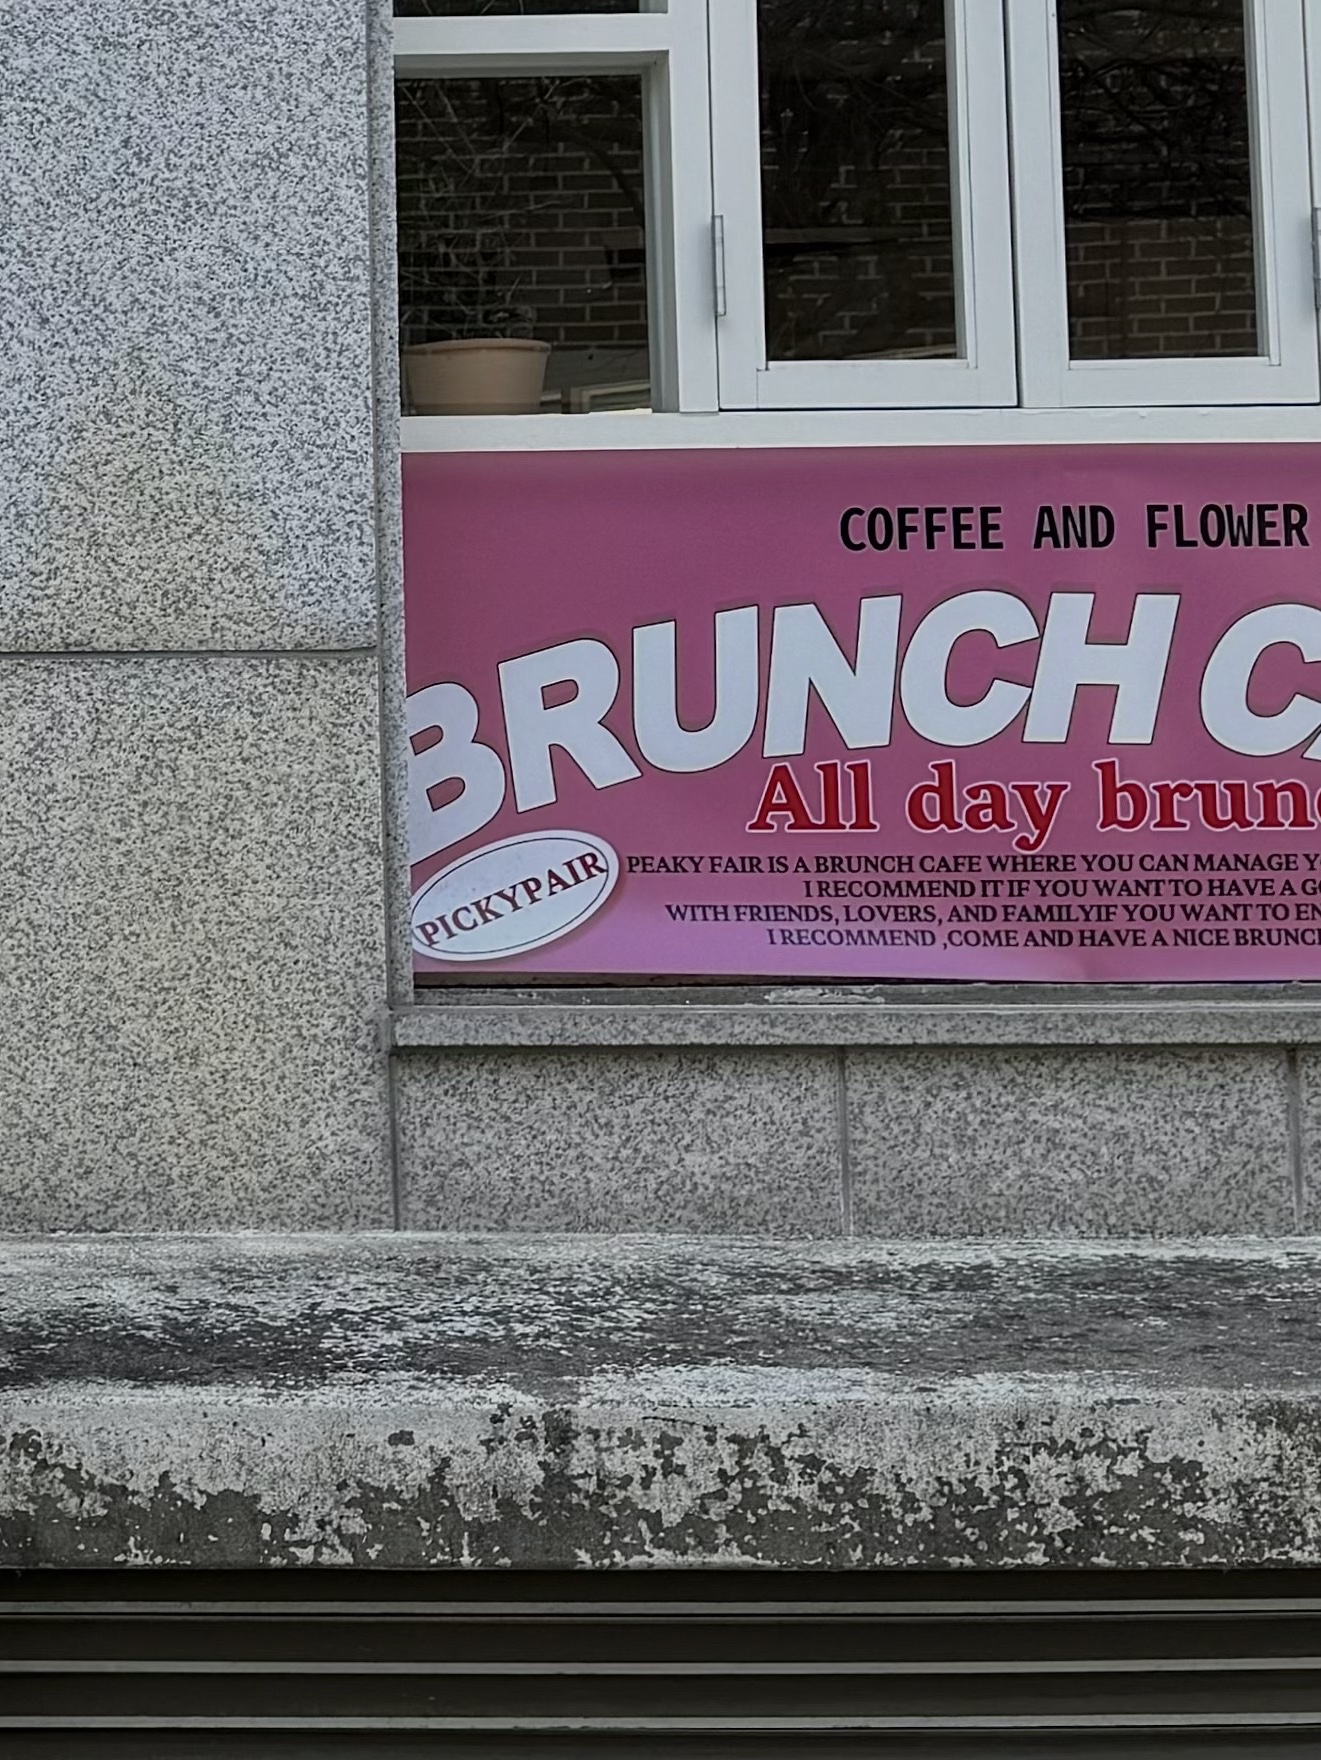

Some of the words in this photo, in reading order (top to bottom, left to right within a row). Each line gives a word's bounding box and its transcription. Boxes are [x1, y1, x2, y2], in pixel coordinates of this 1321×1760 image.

[838, 505, 1005, 553] COFFEE
[1032, 504, 1116, 550] AND
[1144, 502, 1311, 549] FLOWER
[407, 588, 1181, 868] BRUNCH
[746, 759, 880, 832] All
[905, 759, 1071, 852] day
[1091, 757, 1321, 833] brun
[627, 856, 703, 873] PEAKY
[709, 856, 764, 873] FAIR
[768, 856, 789, 873] IS
[793, 856, 811, 873] A
[815, 855, 914, 873] BRUNCH
[919, 855, 982, 873] CAFE
[988, 854, 1077, 873] WHERE
[1081, 854, 1135, 872] YOU
[1139, 854, 1190, 872] CAN
[1194, 854, 1299, 871] MANAGE
[416, 851, 609, 947] PICKYPAIR
[804, 881, 813, 897] I
[817, 880, 976, 897] RECOMMEND
[980, 880, 1005, 897] IT
[1008, 880, 1030, 897] IF
[1034, 880, 1089, 897] YOU
[1093, 879, 1166, 897] WANT
[1169, 879, 1202, 896] TO
[1208, 879, 1276, 896] HAVE
[1280, 879, 1297, 896] A
[666, 905, 730, 921] WITH
[735, 905, 840, 926] FRIENDS,
[844, 905, 943, 926] LOVERS,
[948, 905, 998, 922] AND
[1122, 904, 1176, 921] YOU
[1180, 904, 1253, 921] WANT
[1256, 904, 1290, 921] TO
[768, 929, 779, 945] I
[781, 929, 936, 946] RECOMMEND
[1024, 930, 1074, 946] AND
[1079, 929, 1147, 946] HAVE
[1151, 929, 1169, 946] A
[1173, 929, 1230, 946] NICE
